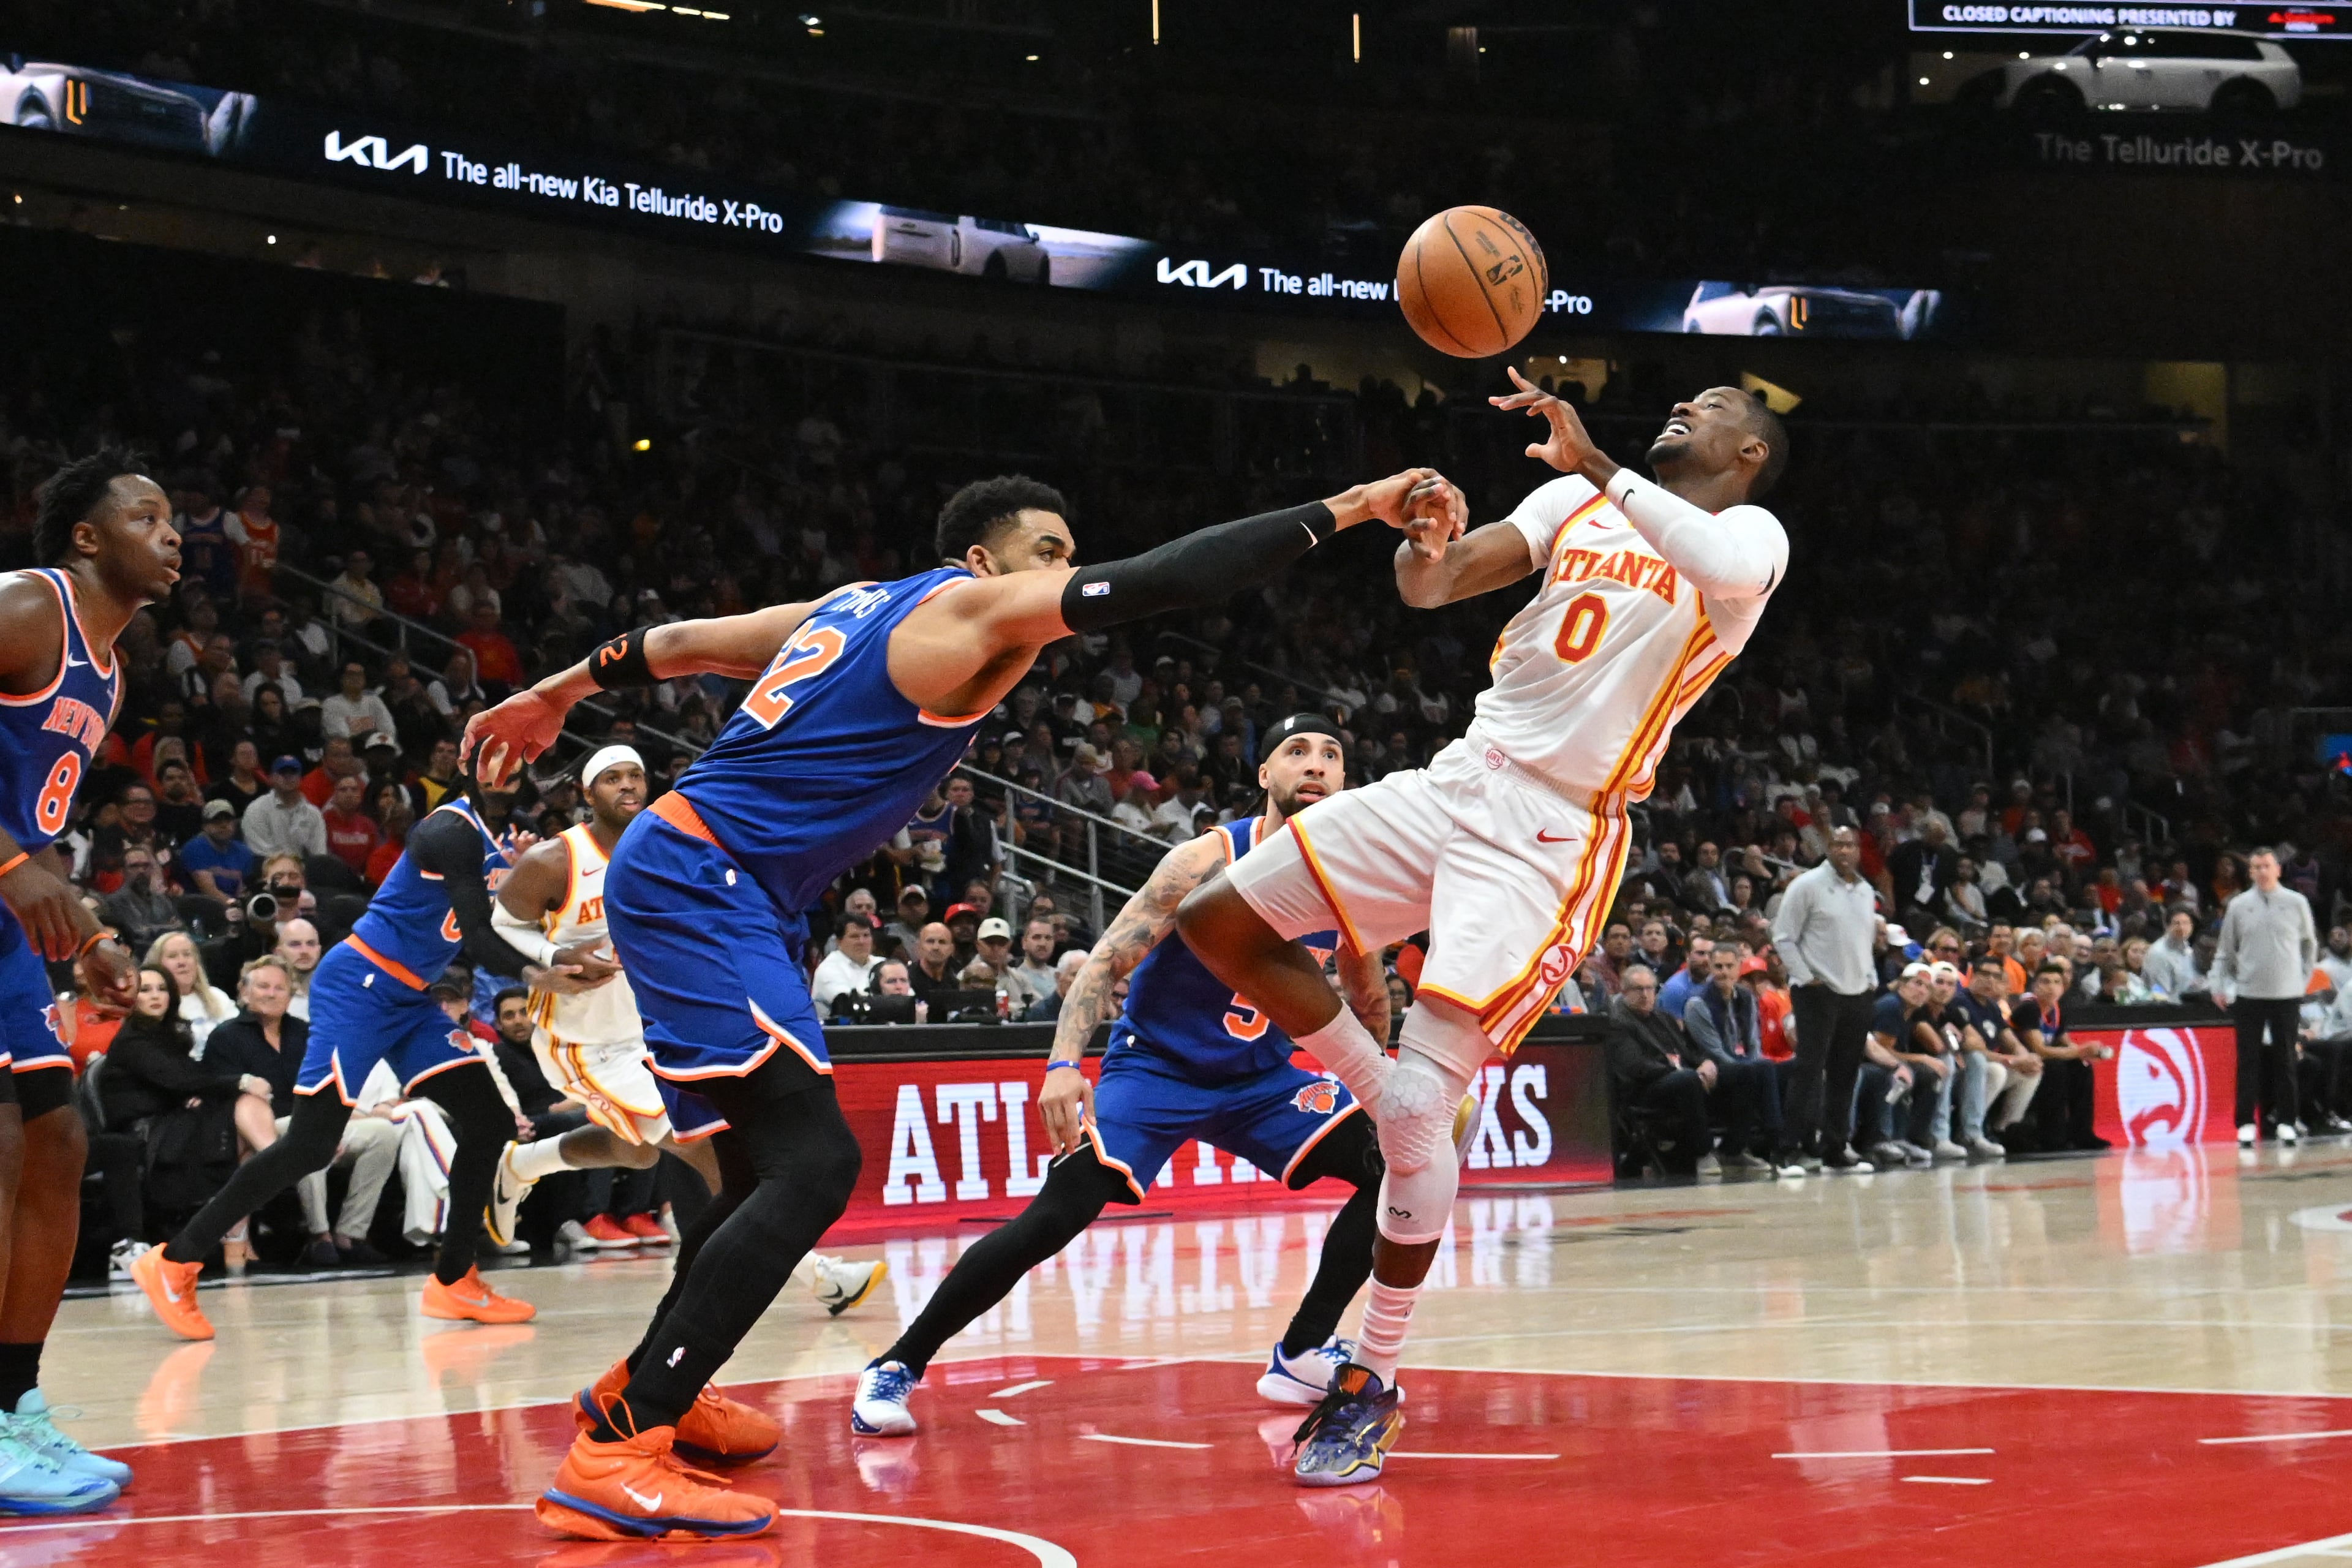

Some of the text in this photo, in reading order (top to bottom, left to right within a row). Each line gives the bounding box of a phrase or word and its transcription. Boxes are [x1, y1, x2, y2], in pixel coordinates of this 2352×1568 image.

[1943, 4, 2236, 27] CLOSED CAPTIONING PRESENTED BY
[325, 130, 428, 174] KIA
[2034, 133, 2324, 170] The Telluride X-Pro
[440, 151, 783, 233] The all-new Kia Telluride X-Pro
[1156, 257, 1247, 290] KIA
[1259, 268, 1303, 295] The
[1307, 273, 1389, 301] all-new
[1542, 290, 1593, 315] -Pro
[1554, 592, 1610, 665] 0
[36, 750, 81, 837] 8
